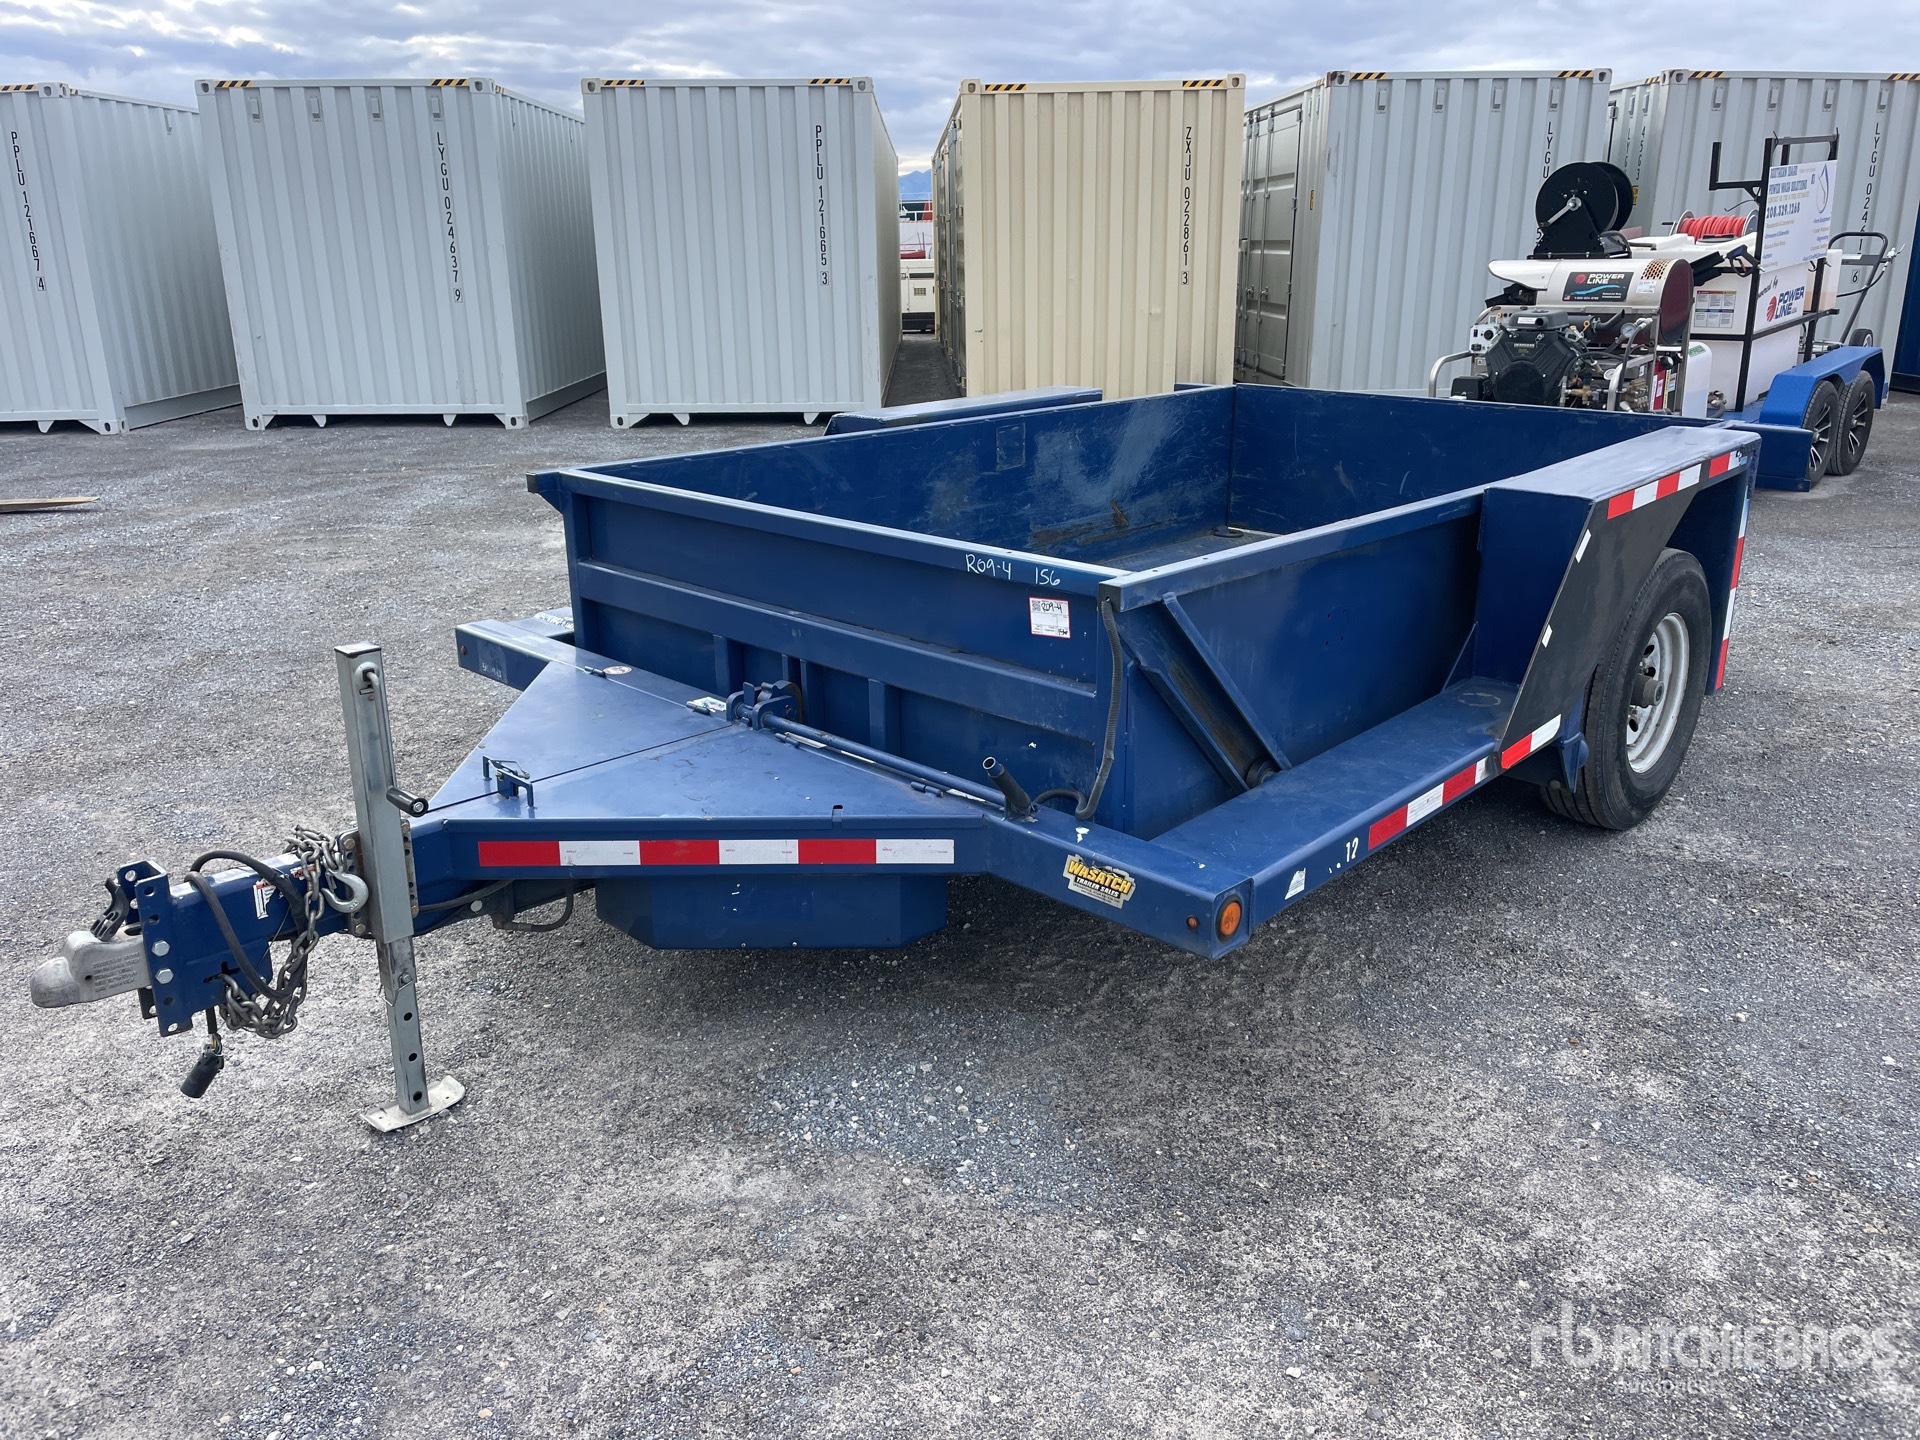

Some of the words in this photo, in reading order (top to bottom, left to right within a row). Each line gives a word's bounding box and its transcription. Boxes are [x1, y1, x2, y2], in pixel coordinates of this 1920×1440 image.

[815, 125, 823, 180] PPLU
[1542, 122, 1553, 178] LYGU
[1869, 122, 1880, 177] LYGU
[11, 131, 25, 185] PPLU
[22, 190, 40, 271] 121667
[37, 277, 45, 290] 4
[437, 132, 449, 190] LYGU
[444, 197, 458, 282] 024637
[454, 289, 461, 301] 9
[818, 185, 827, 265] 121665
[821, 271, 828, 285] 3
[1182, 271, 1188, 284] 3
[1775, 303, 1792, 319] LINE
[1778, 286, 1805, 305] POWER
[1035, 567, 1061, 586] 156
[1068, 860, 1132, 894] WASATCH
[1076, 877, 1100, 890] TRAILER
[1099, 886, 1120, 898] SALES
